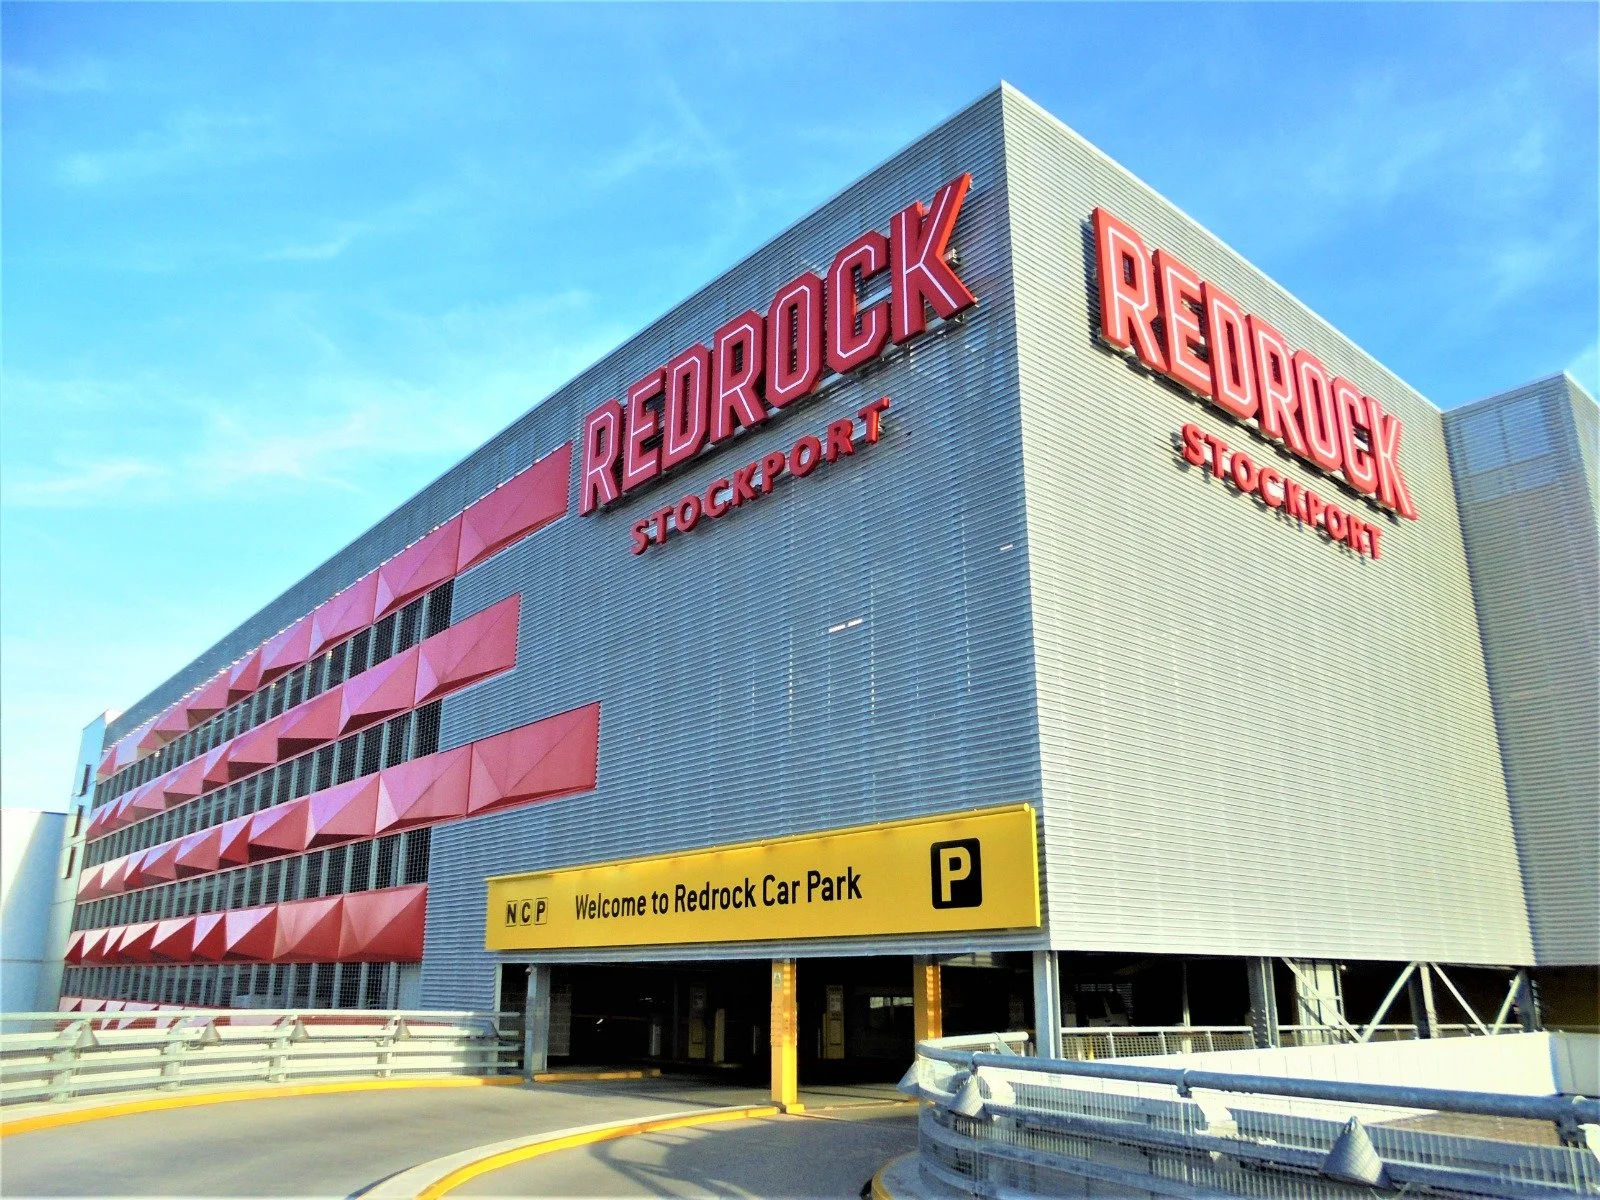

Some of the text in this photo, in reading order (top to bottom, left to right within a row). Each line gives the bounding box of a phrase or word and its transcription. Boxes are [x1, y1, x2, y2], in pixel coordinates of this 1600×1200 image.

[579, 172, 978, 517] REDROCK
[1092, 207, 1418, 520] REDROCK
[630, 396, 890, 556] STOCKPORT
[1181, 423, 1383, 560] STOCKPORT
[505, 899, 548, 926] NCP
[575, 866, 863, 920] Welcome to Redrock Car Park
[940, 846, 972, 902] P
